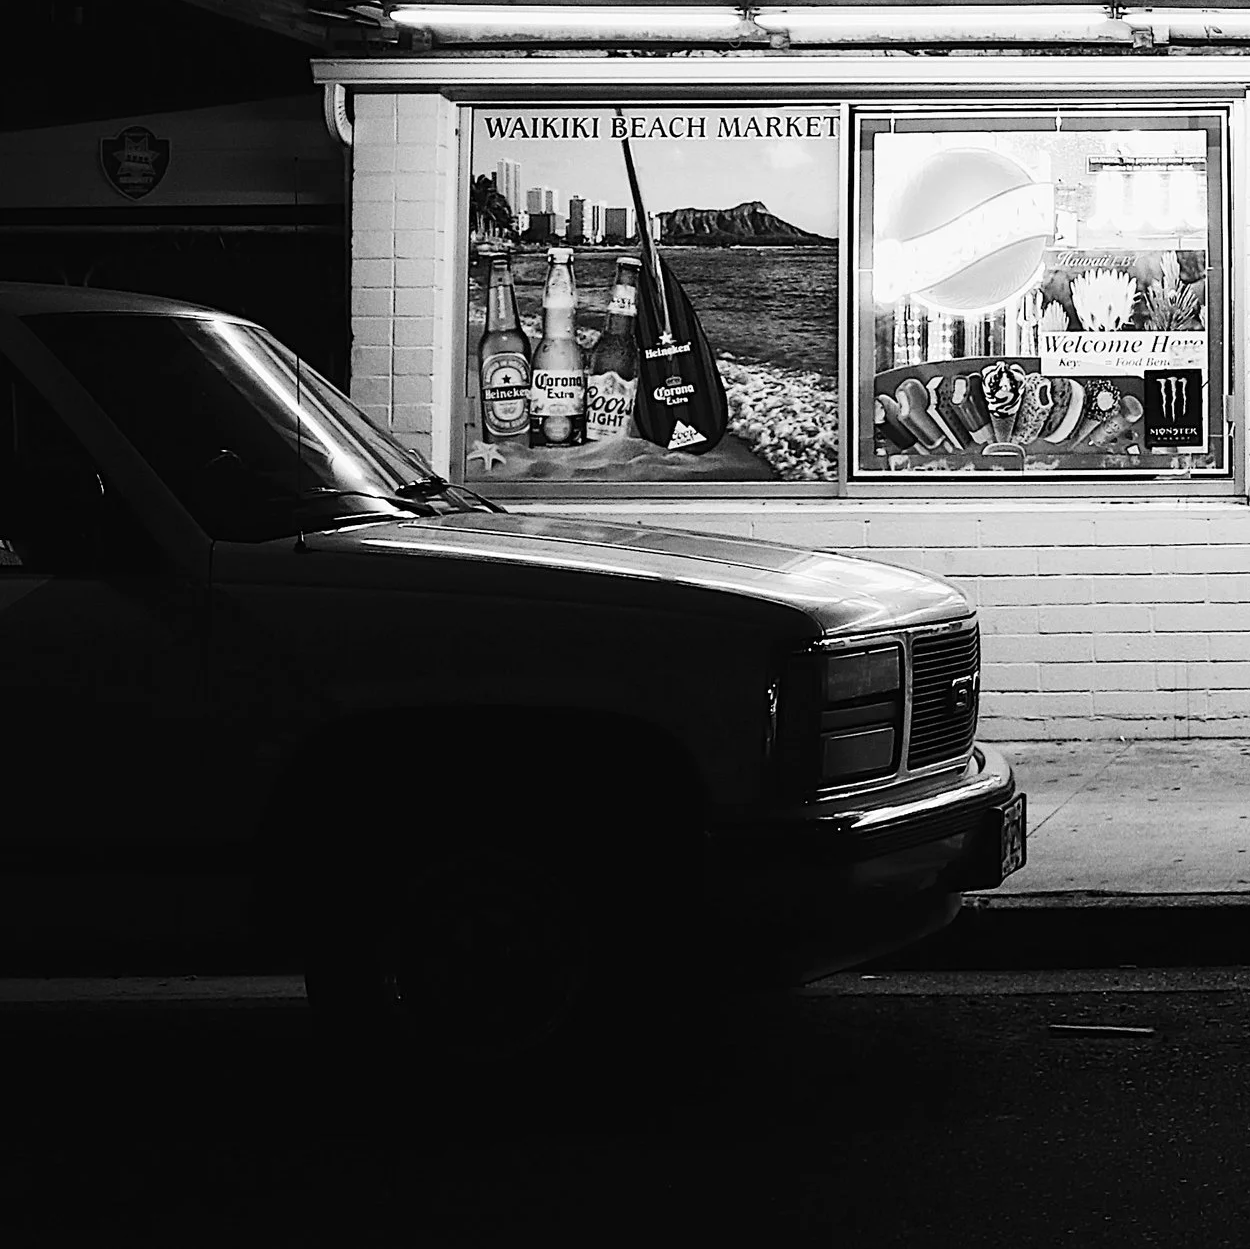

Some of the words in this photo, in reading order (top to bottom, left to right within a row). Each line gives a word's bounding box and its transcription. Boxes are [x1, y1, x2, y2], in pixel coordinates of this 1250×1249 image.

[485, 116, 599, 139] WAIKIKI
[611, 116, 706, 139] BEACH
[718, 116, 840, 138] MARKET
[1055, 251, 1111, 267] Hawaii
[645, 343, 690, 359] Heineken
[1045, 335, 1143, 354] Welcome
[1115, 357, 1142, 367] Food
[535, 373, 583, 390] Corona
[547, 388, 575, 399] Extra
[653, 383, 695, 401] Corona
[587, 385, 634, 416] Coors
[587, 412, 625, 427] LIGHT
[1150, 427, 1197, 436] MONSTER
